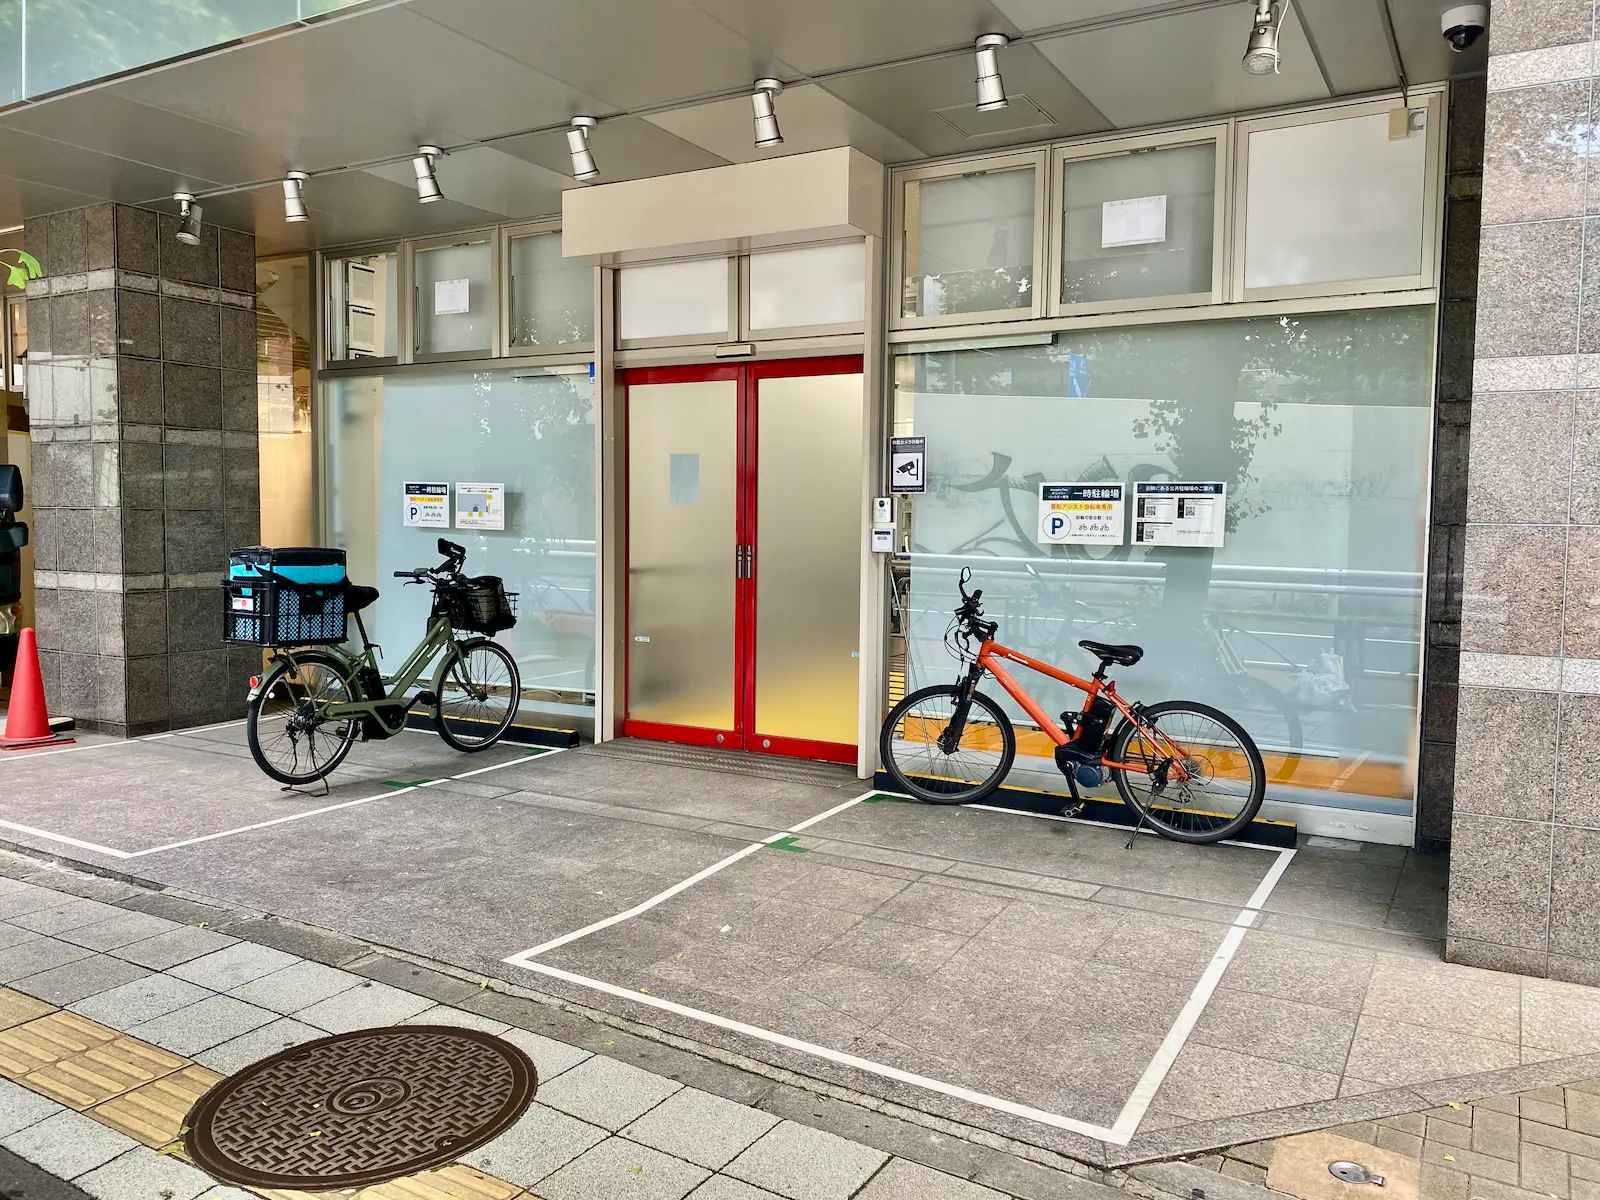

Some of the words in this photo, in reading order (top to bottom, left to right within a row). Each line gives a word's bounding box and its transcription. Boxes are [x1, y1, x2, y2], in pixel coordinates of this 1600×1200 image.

[1074, 489, 1119, 498] 一時駐輪場
[410, 507, 418, 520] P
[1052, 517, 1064, 535] P
